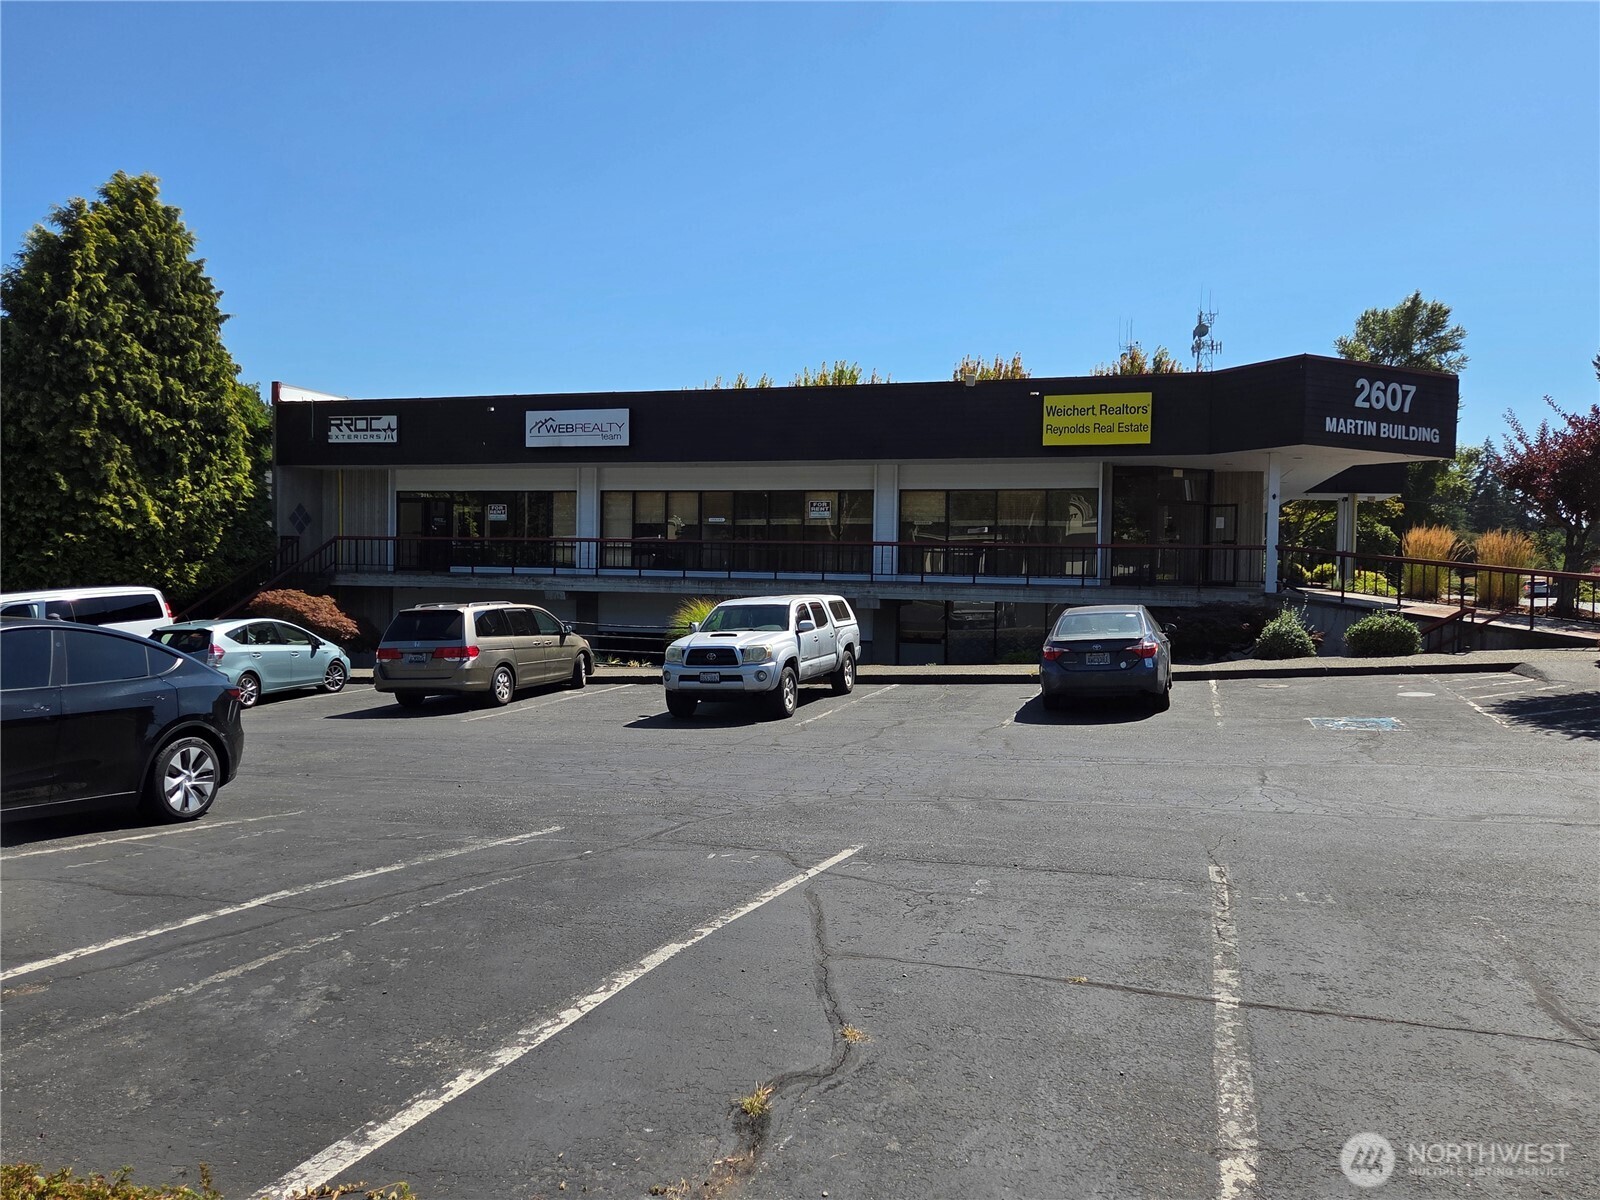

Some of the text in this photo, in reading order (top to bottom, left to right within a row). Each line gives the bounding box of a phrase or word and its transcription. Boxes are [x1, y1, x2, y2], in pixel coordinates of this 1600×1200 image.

[1354, 378, 1417, 413] 2607
[601, 433, 622, 441] team
[1046, 422, 1149, 436] Reynolds Real Estate
[1325, 416, 1440, 443] MARTIN BUILDING
